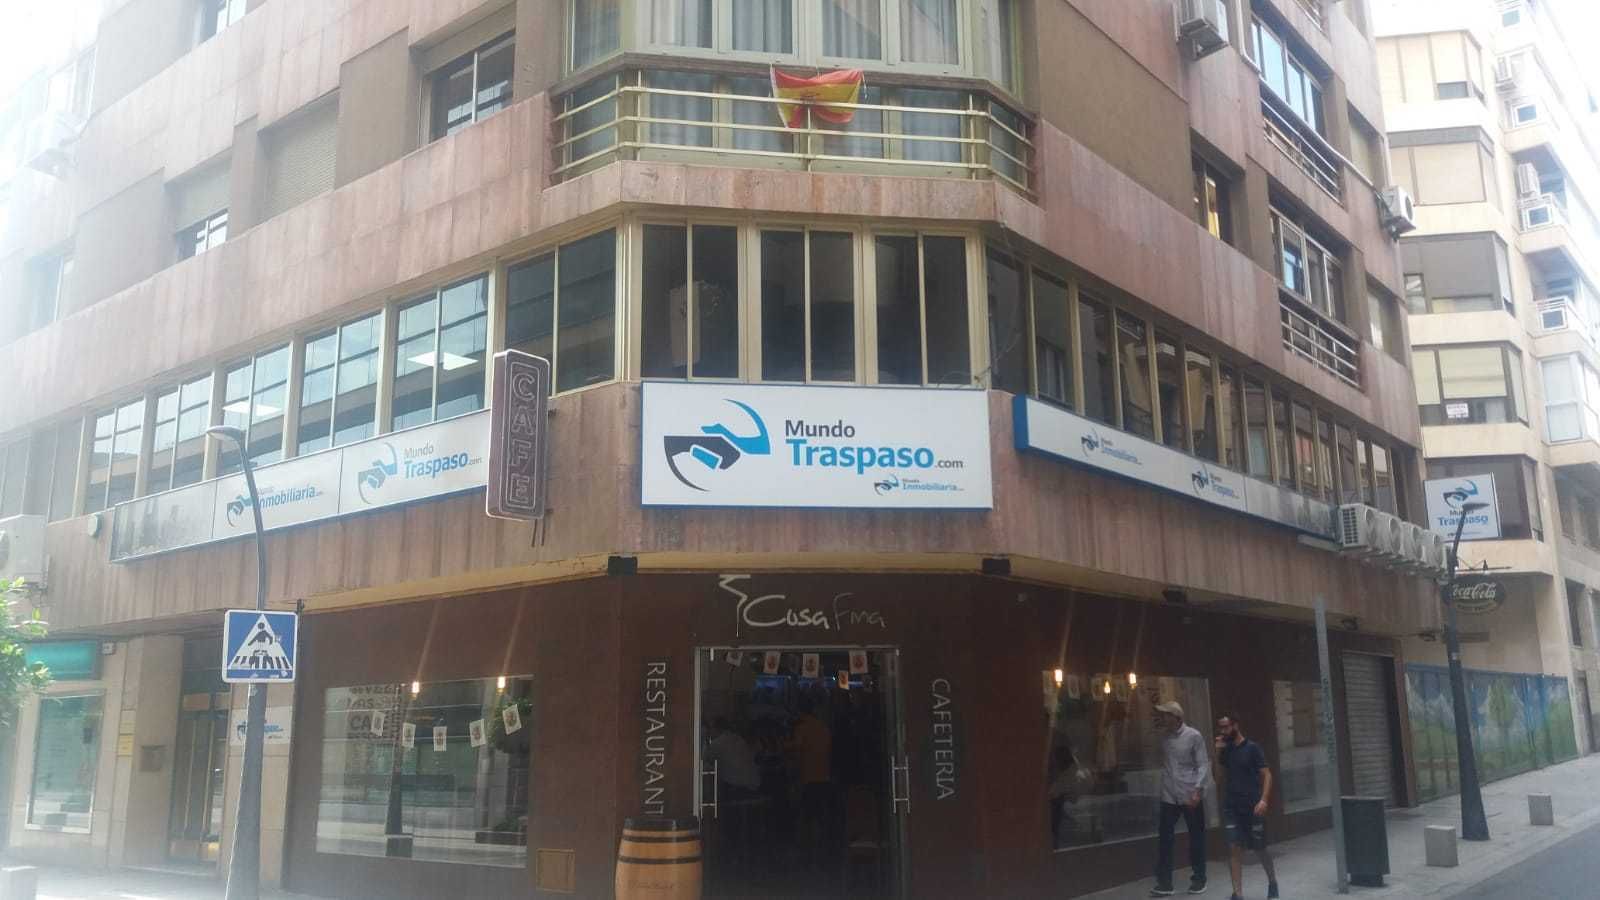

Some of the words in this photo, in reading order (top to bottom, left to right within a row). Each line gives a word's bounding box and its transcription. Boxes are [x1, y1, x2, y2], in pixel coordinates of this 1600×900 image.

[785, 419, 856, 439] Mundo
[404, 443, 434, 458] Mundo
[932, 678, 955, 801] CAFETERIA
